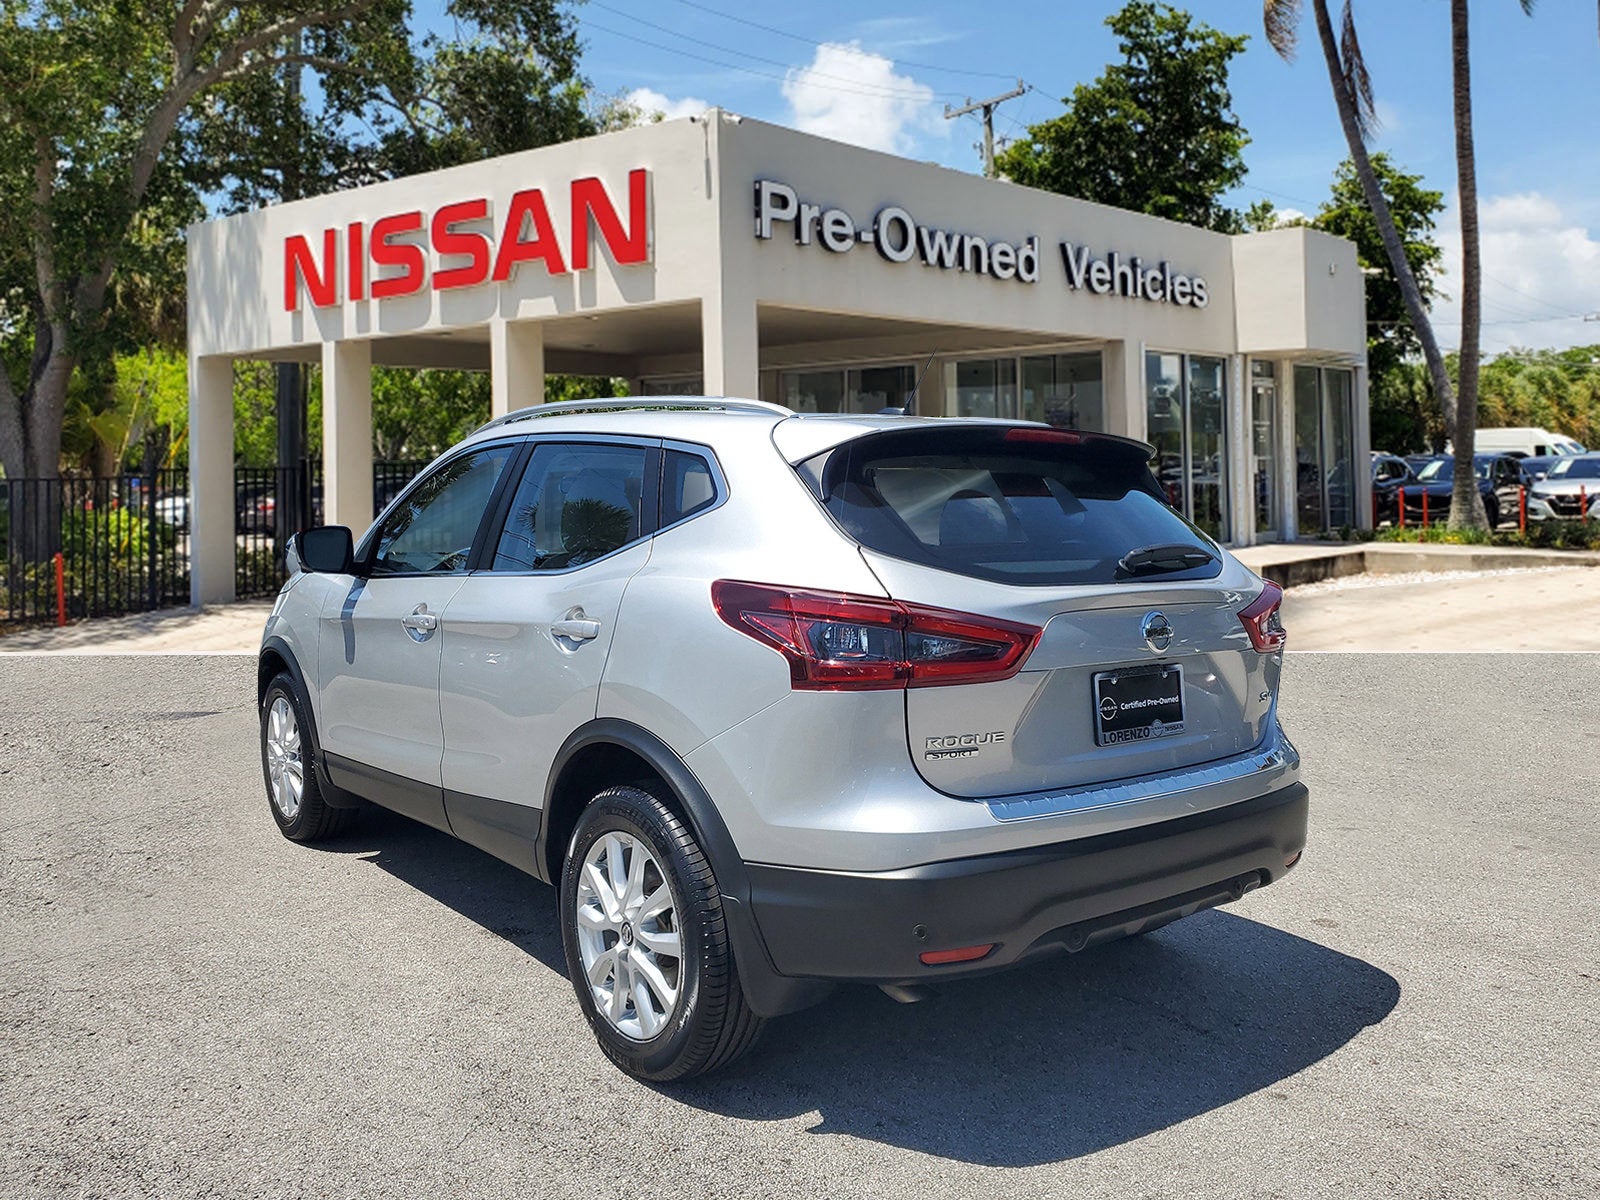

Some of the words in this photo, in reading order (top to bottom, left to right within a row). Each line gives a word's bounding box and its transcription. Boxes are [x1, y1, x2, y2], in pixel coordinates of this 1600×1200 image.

[285, 168, 648, 312] NISSAN
[755, 180, 1040, 283] Pre-Owned
[1061, 241, 1209, 307] Vehicles
[1121, 700, 1147, 710] Certified
[1147, 695, 1178, 706] Pre-Owned
[926, 731, 1005, 749] ROGUE
[1103, 727, 1150, 744] LORENZO
[931, 749, 974, 760] SPORT
